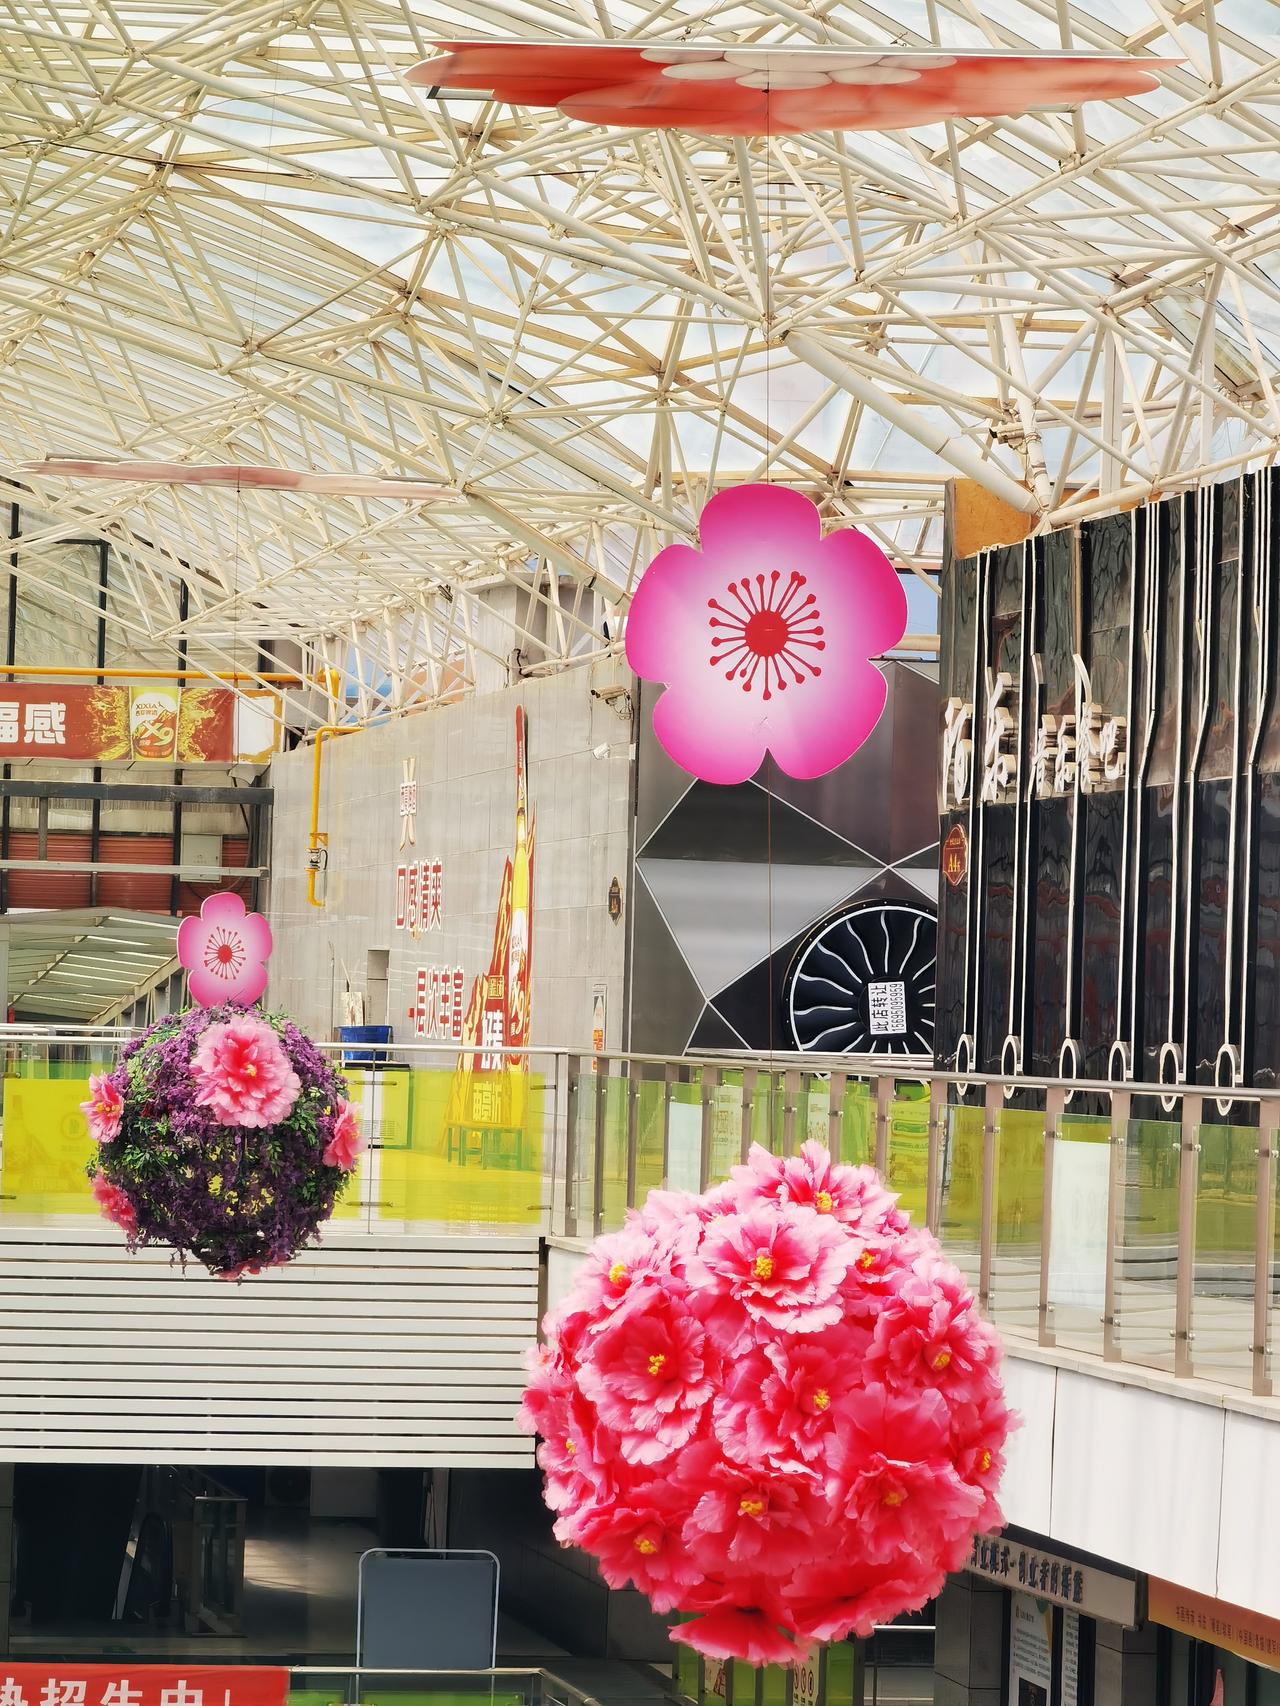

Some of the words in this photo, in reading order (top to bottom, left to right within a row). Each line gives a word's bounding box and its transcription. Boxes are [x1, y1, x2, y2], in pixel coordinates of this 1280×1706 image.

[141, 722, 174, 746] X9
[395, 857, 442, 932] 口感清爽
[414, 965, 464, 1040] 层次丰富
[870, 984, 889, 1032] 此店转让
